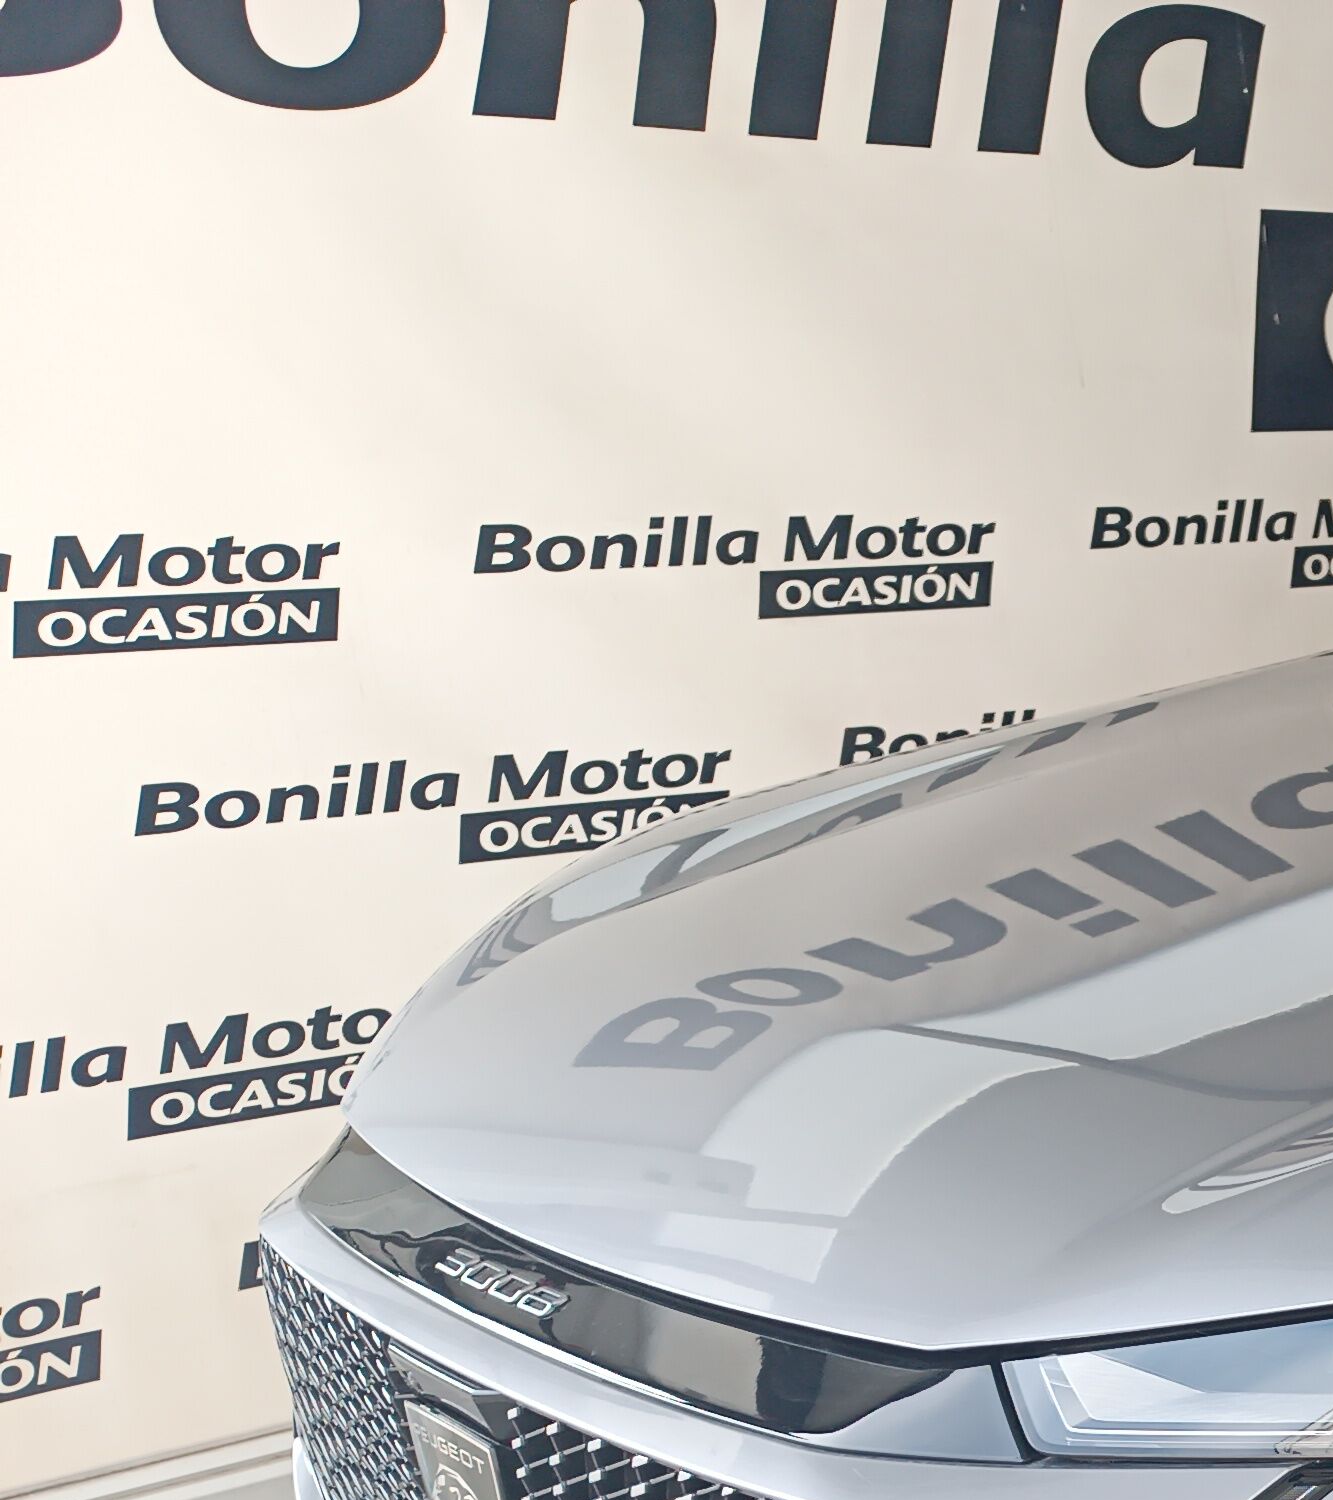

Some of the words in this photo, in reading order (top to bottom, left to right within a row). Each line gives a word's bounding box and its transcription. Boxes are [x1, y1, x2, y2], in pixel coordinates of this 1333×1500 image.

[474, 515, 759, 574] Bonilla
[784, 514, 996, 562] Motor
[1090, 498, 1297, 549] Bonilla
[48, 533, 341, 590] Motor
[776, 566, 980, 611] OCASIÓN
[37, 593, 320, 647] OCASIÓN
[134, 760, 461, 836] Bonilla
[488, 749, 732, 803] Motor
[434, 1247, 571, 1319] 3008
[413, 1422, 485, 1475] PEUGEOT
